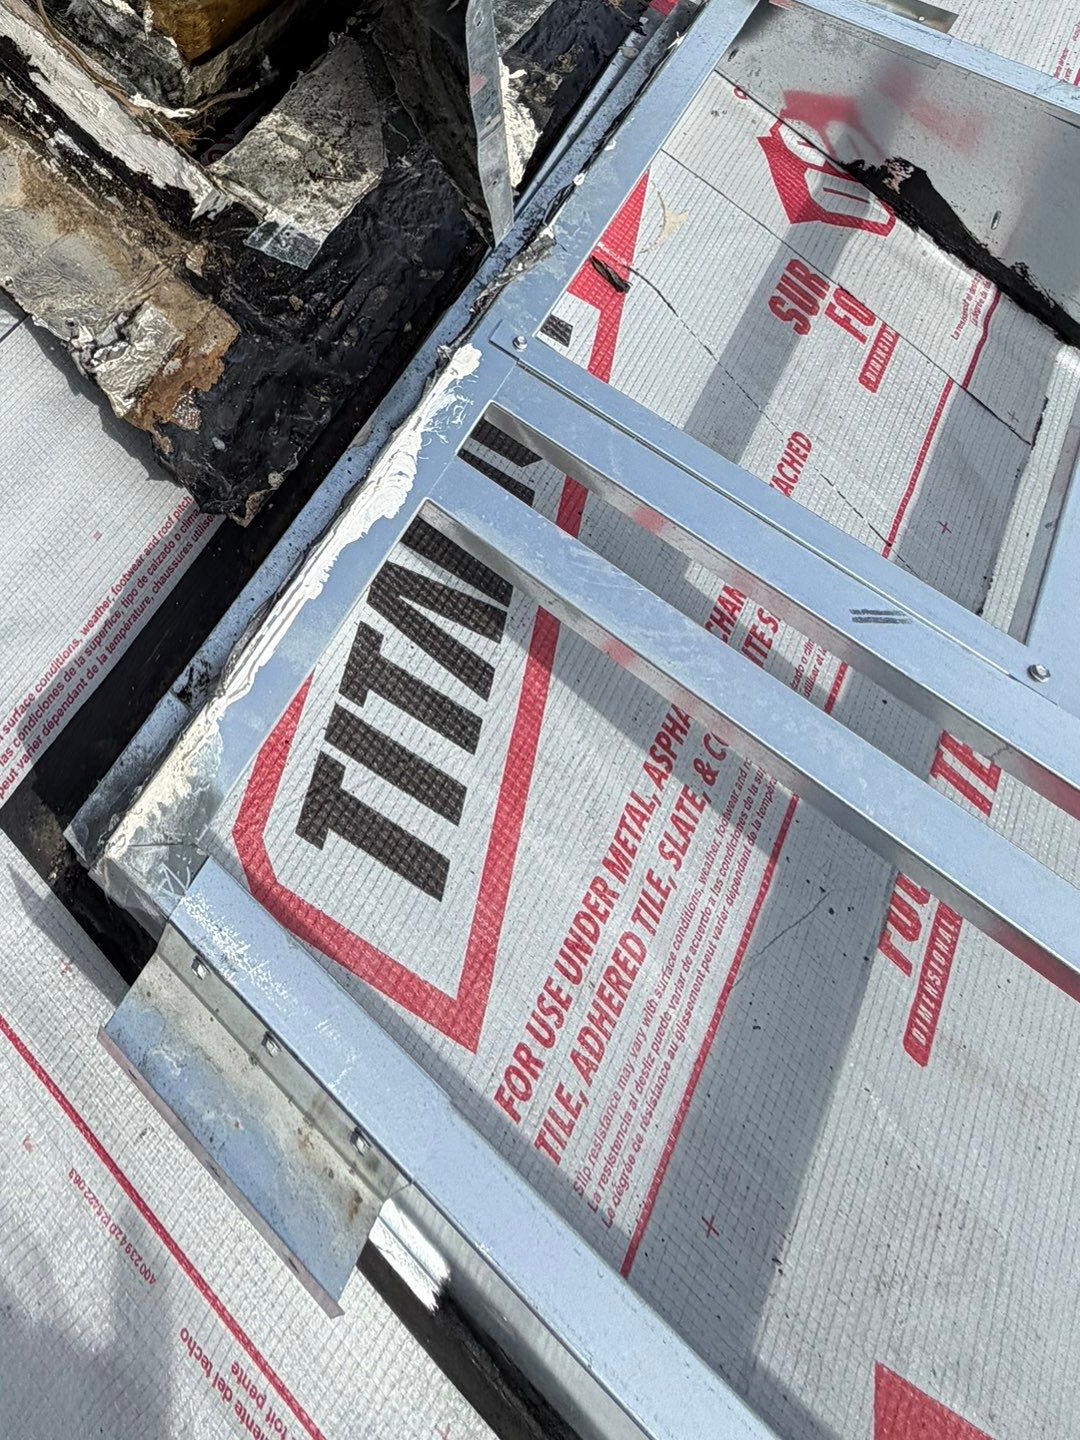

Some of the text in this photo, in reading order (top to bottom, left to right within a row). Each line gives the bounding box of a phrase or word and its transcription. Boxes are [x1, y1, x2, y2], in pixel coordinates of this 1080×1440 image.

[2, 691, 36, 735] surface
[34, 636, 84, 694] conditions,
[79, 595, 116, 637] weather,
[110, 553, 146, 597] footwear
[143, 535, 162, 558] and
[157, 517, 176, 538] roof
[172, 494, 194, 523] pitch
[12, 681, 65, 748] condiciones
[63, 665, 78, 683] de
[73, 654, 87, 669] la
[83, 607, 125, 657] superficie,
[120, 587, 141, 611] tipo
[136, 574, 150, 590] de
[146, 539, 177, 578] calzado
[179, 508, 201, 535] clima
[15, 735, 44, 770] varier
[40, 677, 90, 738] dépendant
[86, 664, 100, 680] de
[95, 652, 109, 667] la
[150, 542, 194, 595] chaussures
[743, 794, 755, 818] de
[750, 780, 760, 798] la
[718, 814, 747, 878] condiciones
[711, 878, 725, 902] las
[493, 1041, 547, 1126] FOR
[524, 976, 574, 1050] USE
[553, 874, 621, 988] UNDER
[600, 790, 663, 886] METAL,
[687, 910, 712, 961] acuerdo
[533, 1081, 591, 1167] TILE,
[569, 929, 648, 1088] ADHERED
[630, 867, 679, 938] TILE,
[656, 783, 714, 873] SLATE,
[692, 757, 720, 788] &
[572, 1165, 591, 1198] Slip
[587, 1090, 622, 1164] resistance
[617, 1059, 637, 1094] may
[629, 1025, 648, 1060] vary
[640, 996, 659, 1029] with
[653, 951, 676, 1000] surface
[714, 791, 740, 838] footwear
[732, 768, 748, 794] and
[681, 954, 694, 975] de
[667, 973, 688, 1014] variar
[601, 1210, 617, 1231] Le
[631, 1134, 645, 1155] de
[639, 1060, 672, 1132] résistance
[667, 1042, 680, 1061] au
[674, 972, 708, 1045] glissement
[701, 936, 718, 976] peut
[711, 905, 730, 944] varier
[724, 843, 754, 907] dépendant
[746, 824, 758, 847] de
[752, 812, 763, 832] la
[649, 1010, 673, 1058] puede
[633, 1058, 656, 1096] desliz
[628, 1093, 640, 1114] al
[596, 1112, 634, 1192] resistencia
[587, 1193, 603, 1214] La
[179, 1326, 235, 1404] del techo
[230, 1361, 268, 1409] pente
